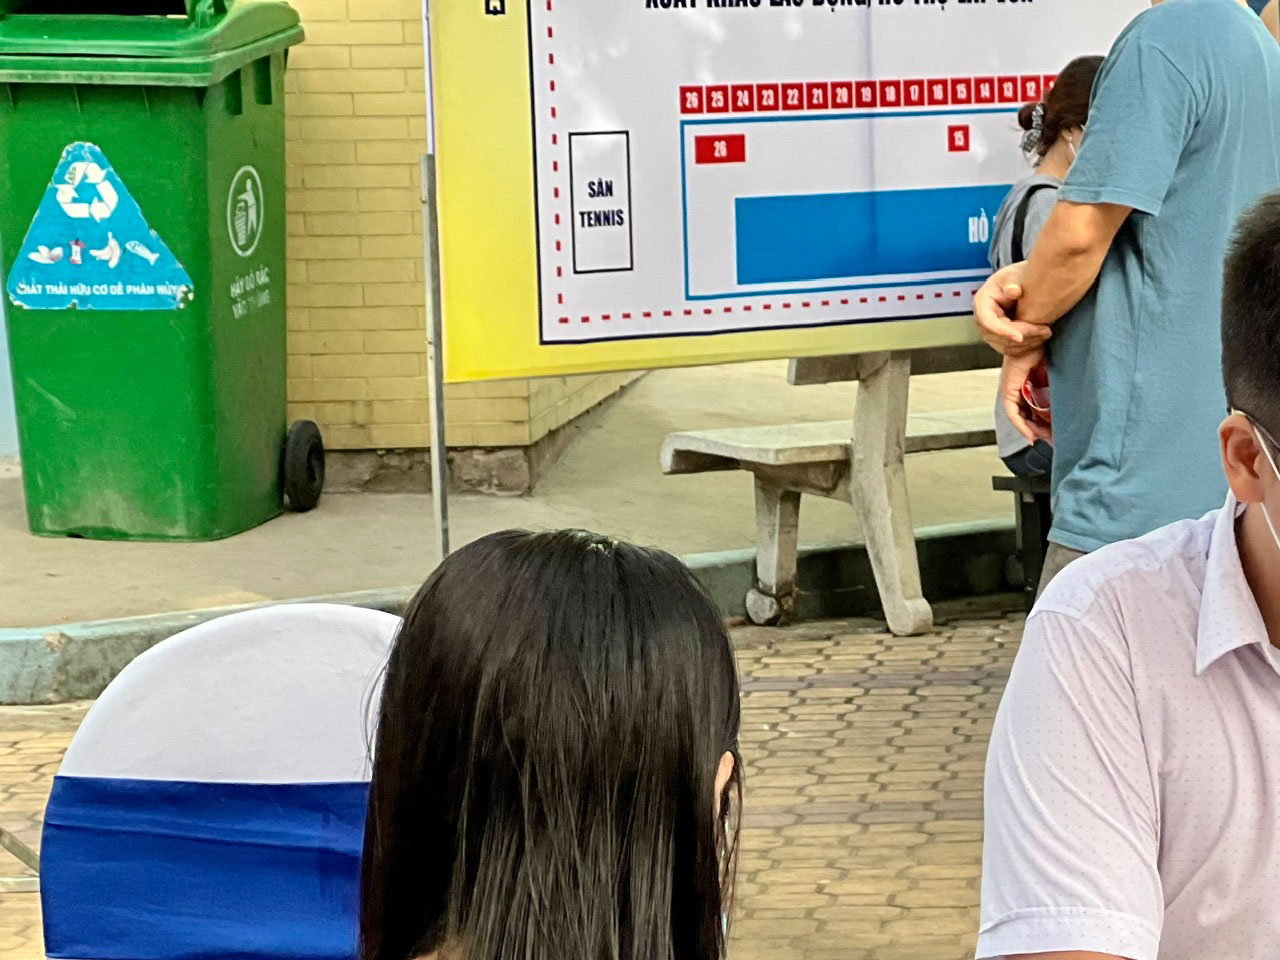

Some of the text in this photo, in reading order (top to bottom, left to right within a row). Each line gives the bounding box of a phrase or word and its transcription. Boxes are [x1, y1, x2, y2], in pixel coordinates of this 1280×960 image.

[685, 91, 699, 109] 26
[711, 91, 724, 108] 25
[736, 90, 749, 107] 24
[761, 89, 774, 106] 23
[786, 88, 799, 105] 22
[812, 88, 824, 104] 21
[836, 87, 848, 103] 20
[860, 86, 872, 102] 19
[885, 85, 896, 102] 18
[909, 84, 919, 101] 17
[932, 84, 943, 100] 16
[955, 83, 967, 99] 15
[979, 82, 990, 98] 14
[1003, 82, 1013, 98] 13
[1026, 81, 1036, 98] 12
[954, 130, 964, 147] 15
[713, 140, 727, 158] 26
[587, 177, 613, 198] SÂN
[579, 209, 624, 228] TENNIS
